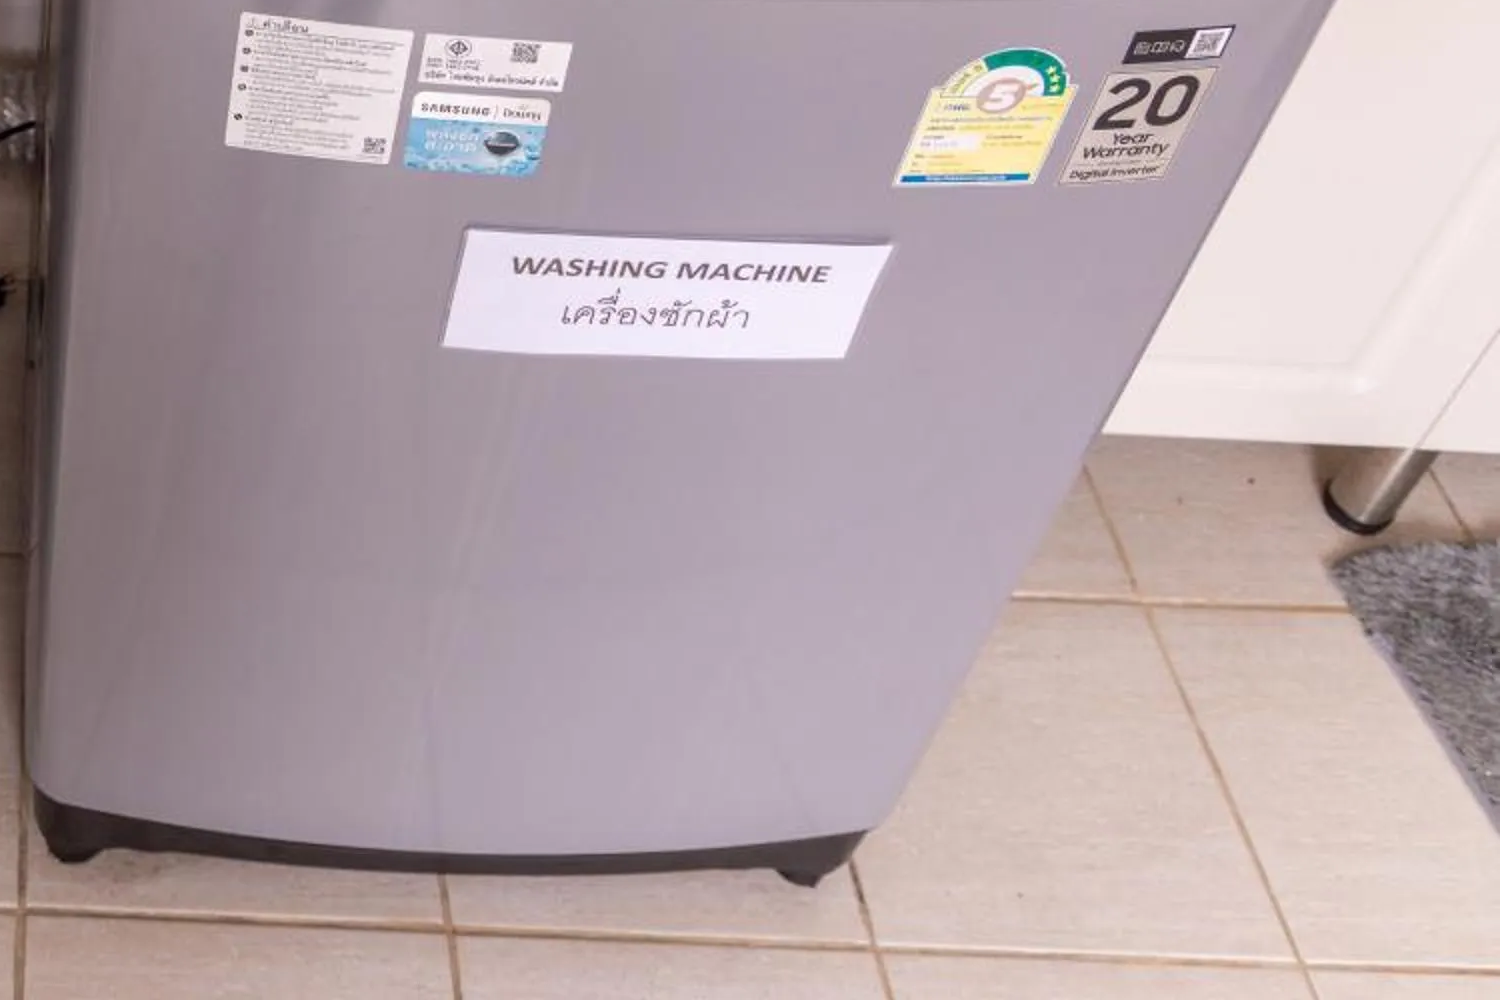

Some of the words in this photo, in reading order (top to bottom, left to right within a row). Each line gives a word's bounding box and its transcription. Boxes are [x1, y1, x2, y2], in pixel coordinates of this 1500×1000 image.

[421, 103, 490, 117] SAMSUNG
[1092, 75, 1201, 131] 20
[1113, 132, 1155, 145] Year
[1083, 143, 1170, 158] Warranty
[1069, 168, 1109, 180] Digital
[1110, 165, 1160, 176] Inverter
[511, 255, 668, 280] WASHING
[676, 261, 832, 284] MACHINE
[560, 287, 750, 330] เครื่องซักผ้า
